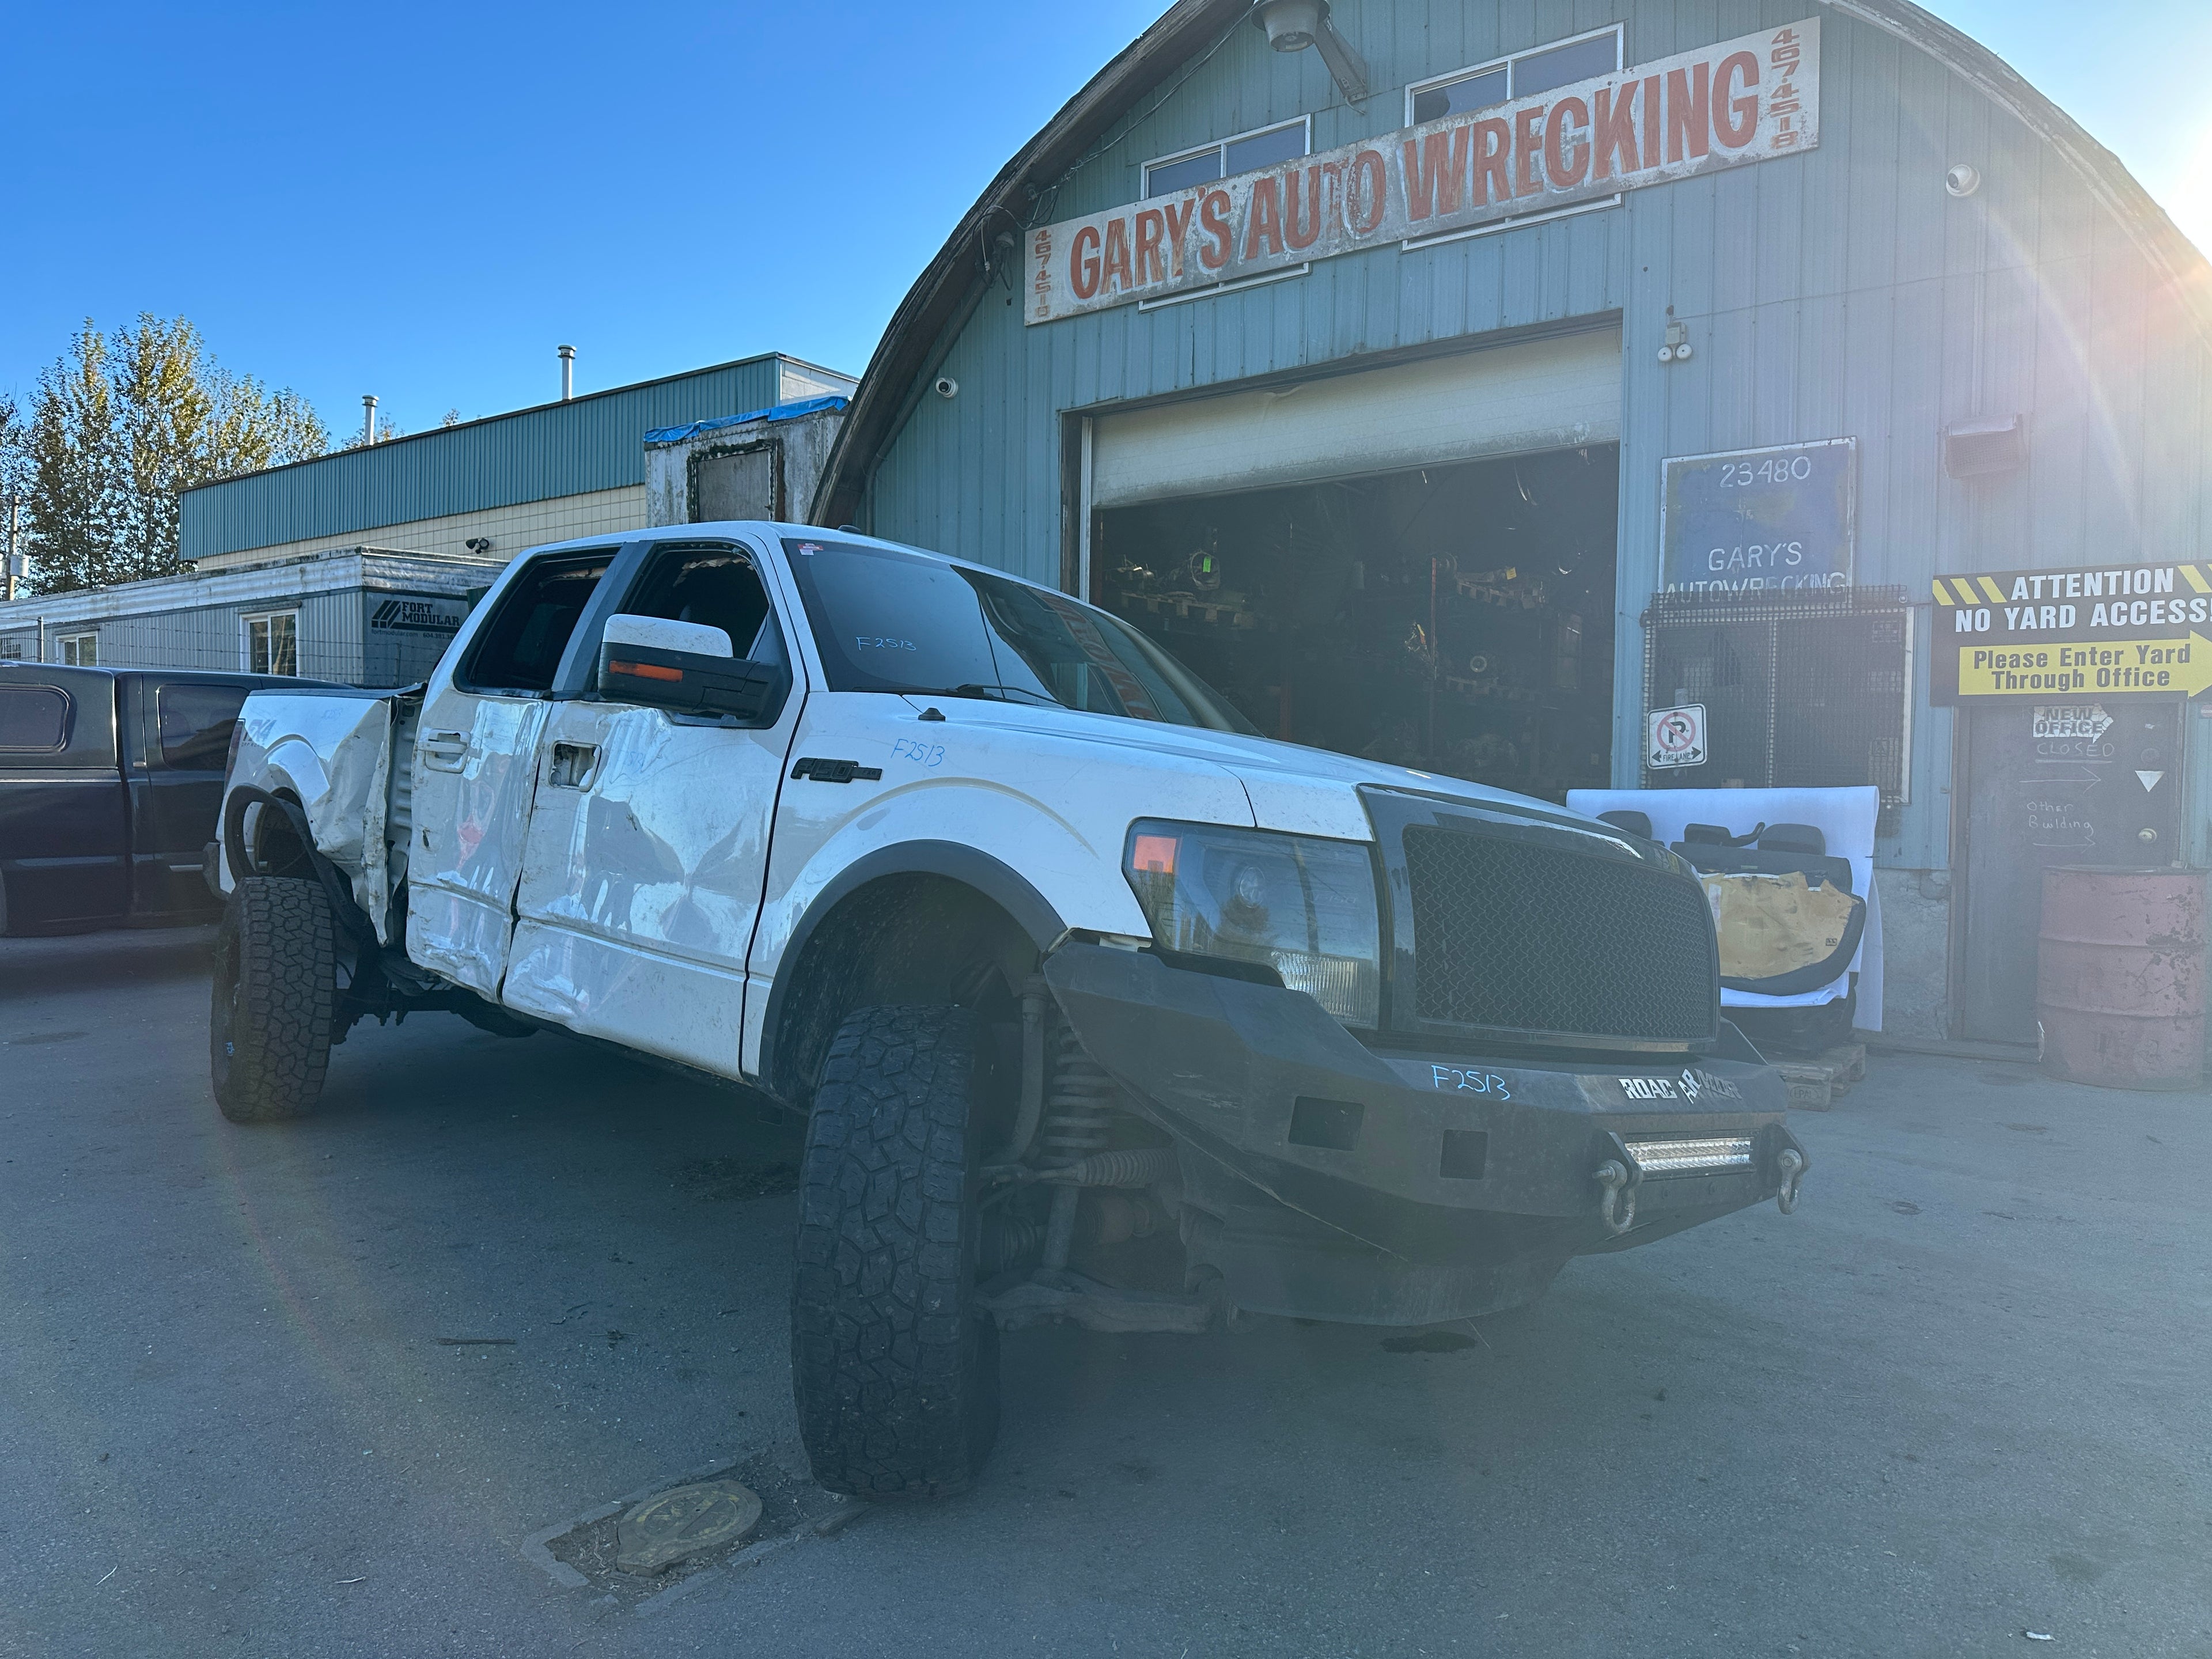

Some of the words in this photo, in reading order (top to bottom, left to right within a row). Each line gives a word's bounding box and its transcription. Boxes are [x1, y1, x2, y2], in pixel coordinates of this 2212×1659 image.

[1070, 187, 1231, 300] GARY'S
[1245, 150, 1387, 260] AUTO
[1404, 50, 1760, 221] WRECKING
[1719, 456, 1812, 488] 23480
[1708, 541, 1802, 572] GARY'S
[2011, 568, 2173, 600] ATTENTION
[402, 601, 433, 613] FORT
[1955, 609, 1991, 632] NO
[2005, 604, 2076, 630] YARD
[402, 612, 460, 626] MODULAR
[372, 628, 419, 637] fortmodular.com
[855, 637, 917, 651] F2513
[1974, 649, 2048, 669] Please
[2060, 647, 2124, 666] Enter
[2135, 643, 2190, 665] Yard
[1991, 669, 2084, 691] Through
[2096, 668, 2170, 687] Office
[2044, 706, 2093, 720] NEW
[2035, 720, 2104, 734] OFFICE
[891, 738, 945, 767] F2513
[2037, 743, 2115, 757] CLOSED
[2029, 815, 2094, 836] Building
[1430, 1065, 1511, 1101] F2513
[1619, 1078, 1678, 1099] ROAD
